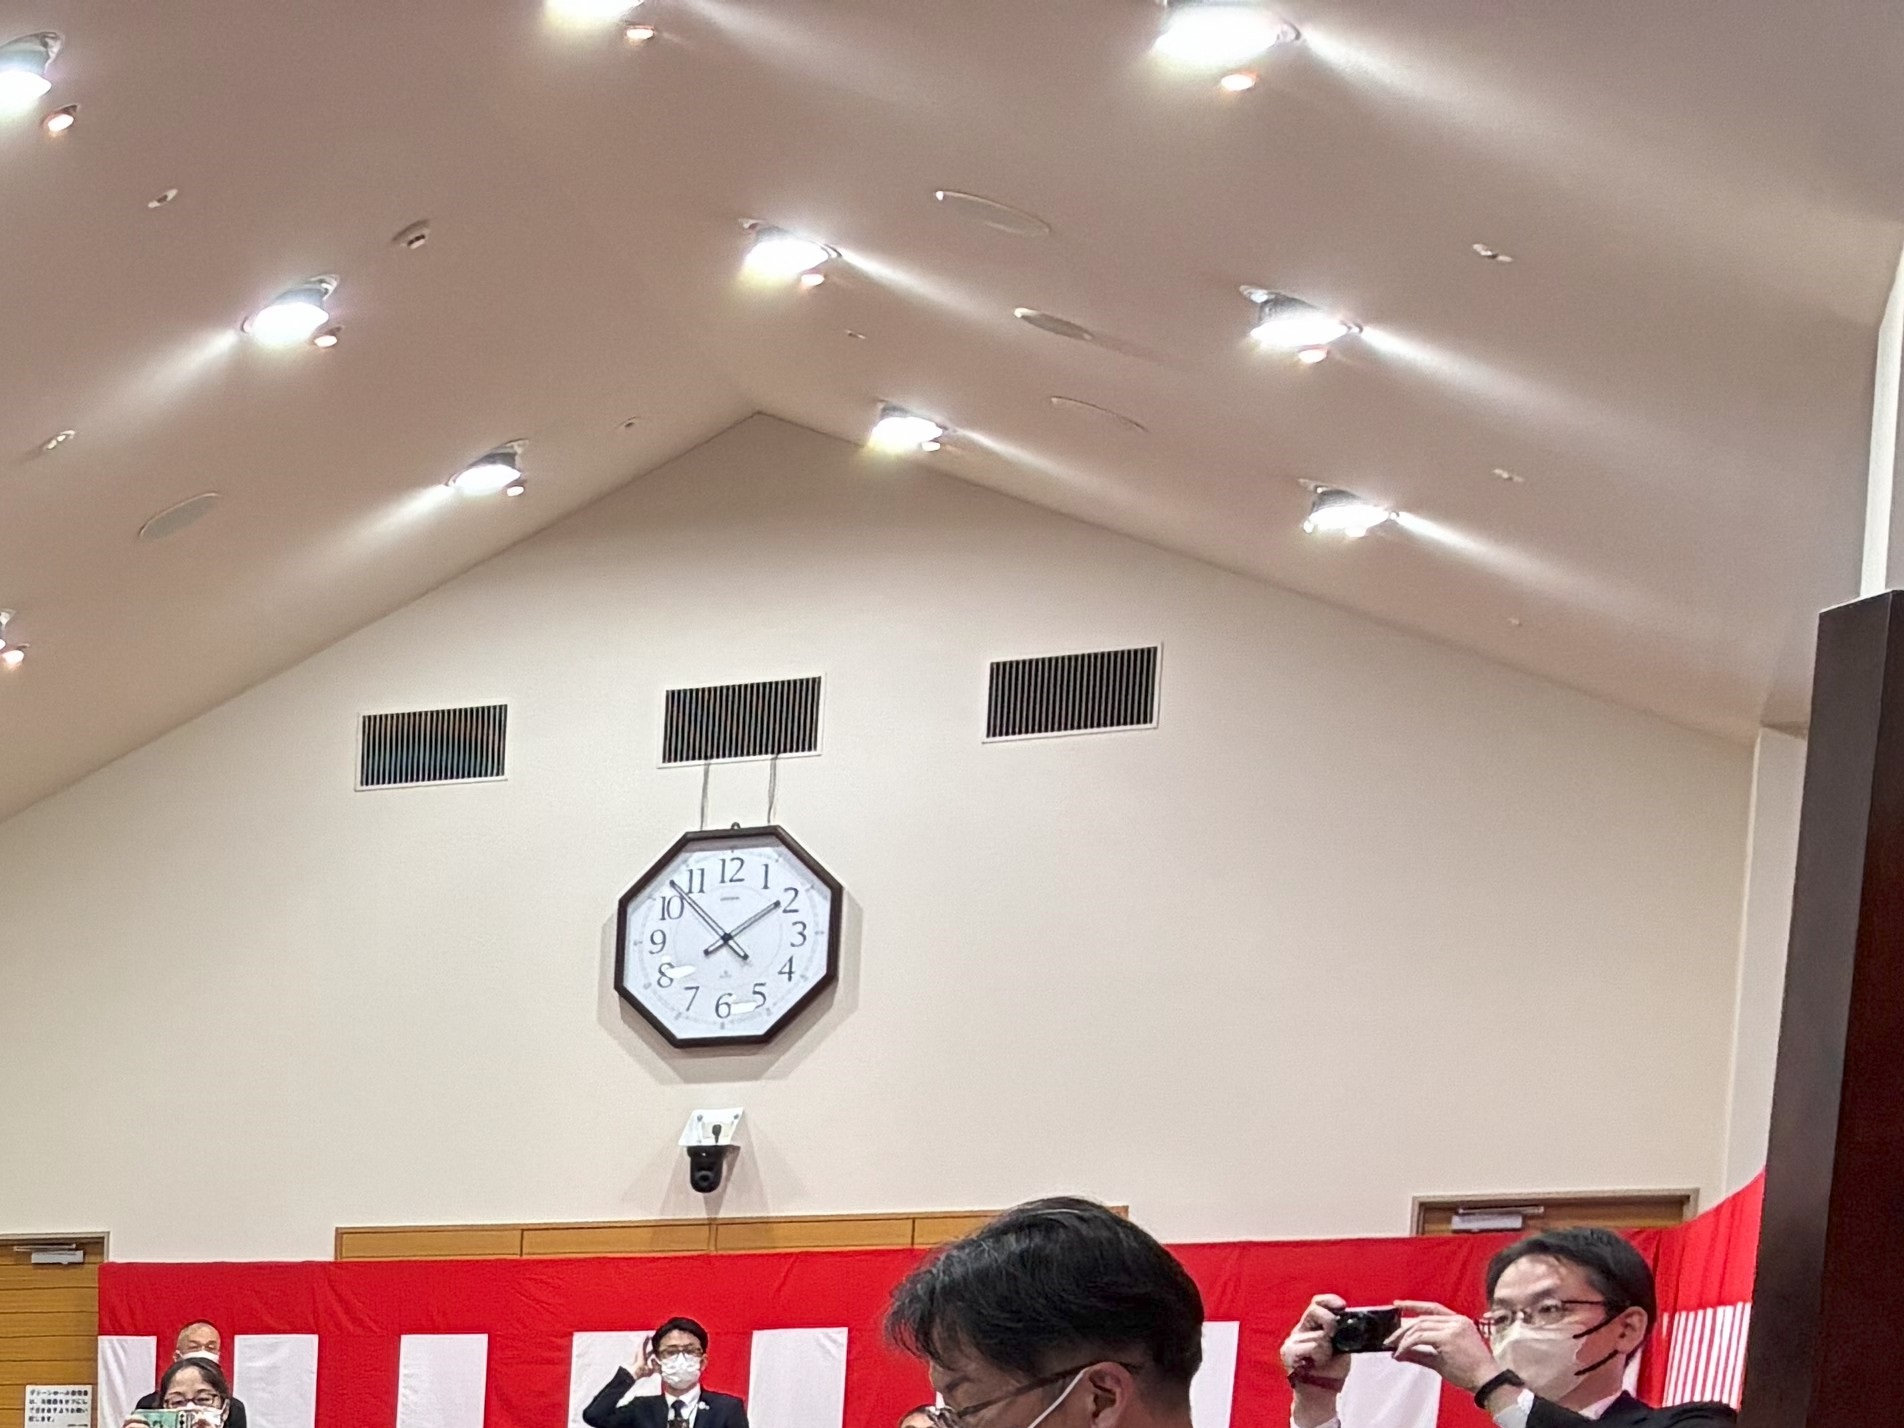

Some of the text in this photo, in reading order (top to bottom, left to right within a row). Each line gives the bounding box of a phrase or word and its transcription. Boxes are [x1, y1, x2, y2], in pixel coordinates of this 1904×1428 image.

[687, 868, 706, 894] 11
[718, 857, 745, 884] 12
[761, 863, 772, 890] 1
[659, 895, 685, 921] 10
[782, 887, 800, 914] 2
[648, 929, 667, 955] 9
[790, 921, 807, 948] 3
[657, 962, 675, 988] 8
[777, 955, 796, 982] 4
[683, 986, 700, 1012] 7
[715, 992, 733, 1019] 6
[752, 982, 767, 1009] 5
